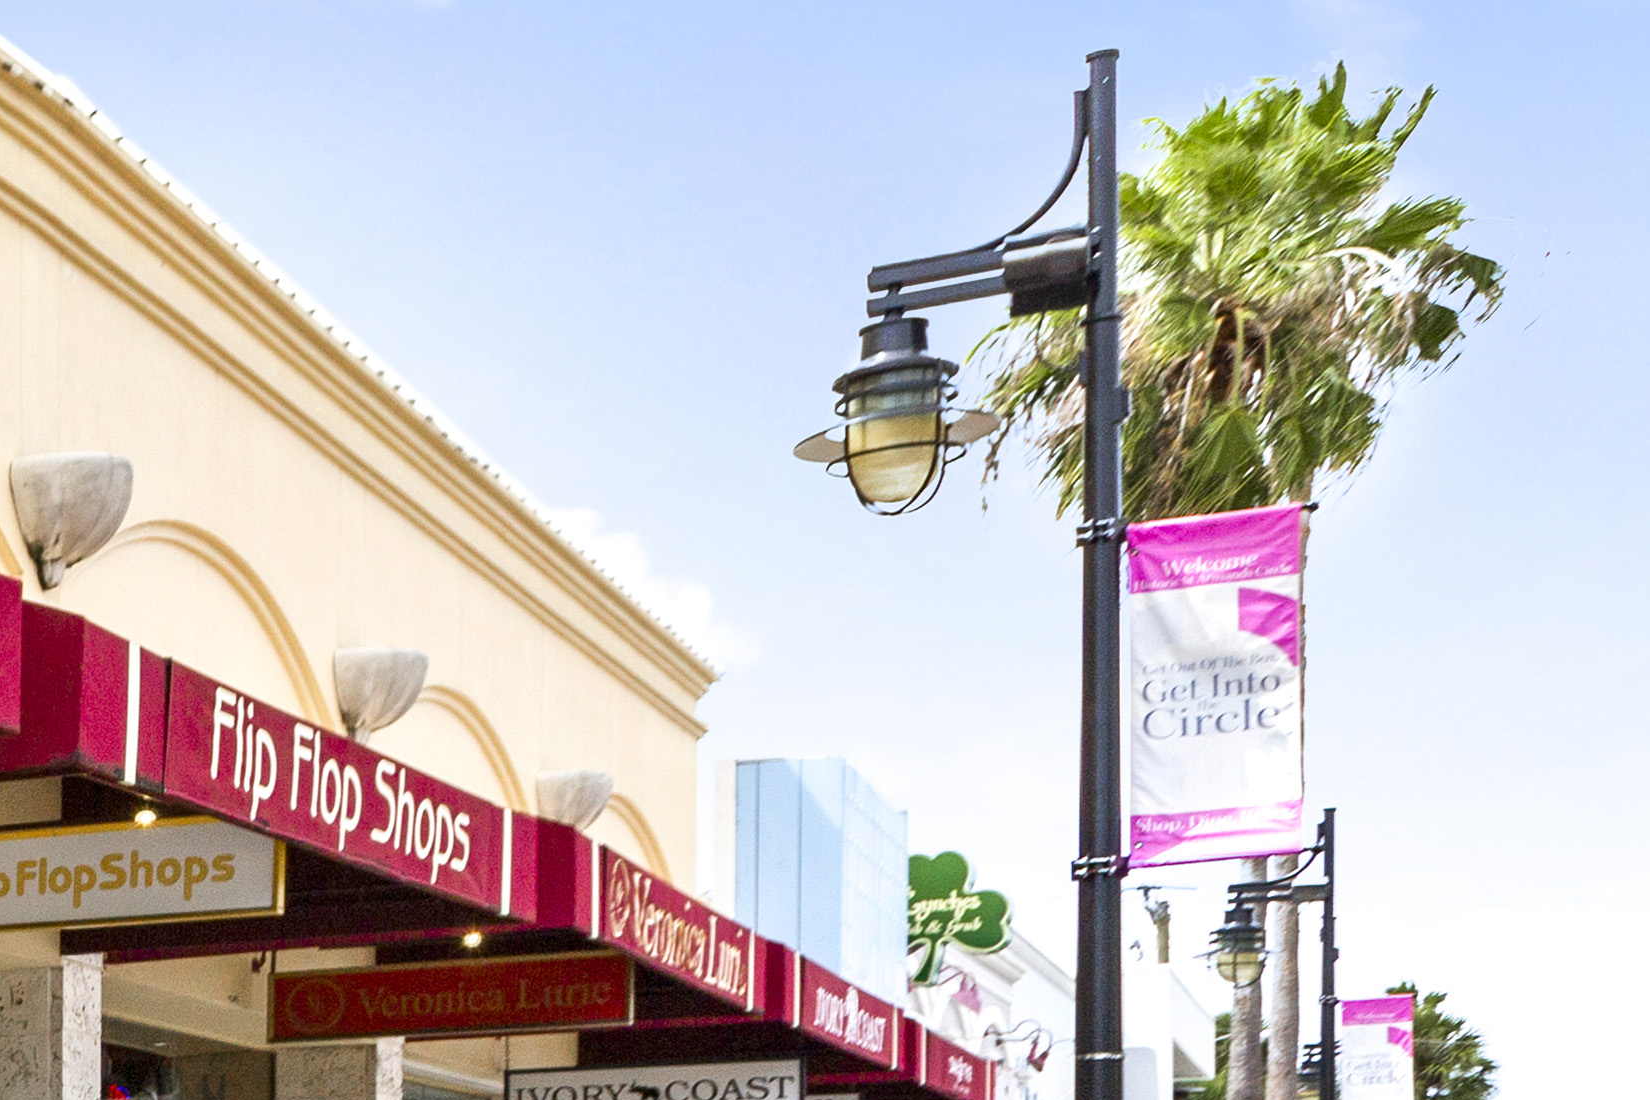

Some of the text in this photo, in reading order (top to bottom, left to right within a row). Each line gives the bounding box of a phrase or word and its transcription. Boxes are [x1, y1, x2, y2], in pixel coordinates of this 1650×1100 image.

[1162, 554, 1259, 578] Welcome
[1142, 672, 1281, 704] Get Into
[1143, 698, 1282, 741] Circle
[210, 686, 471, 886] Flip Flop Shops
[633, 871, 707, 978] Veronica
[359, 980, 507, 1019] Veronica
